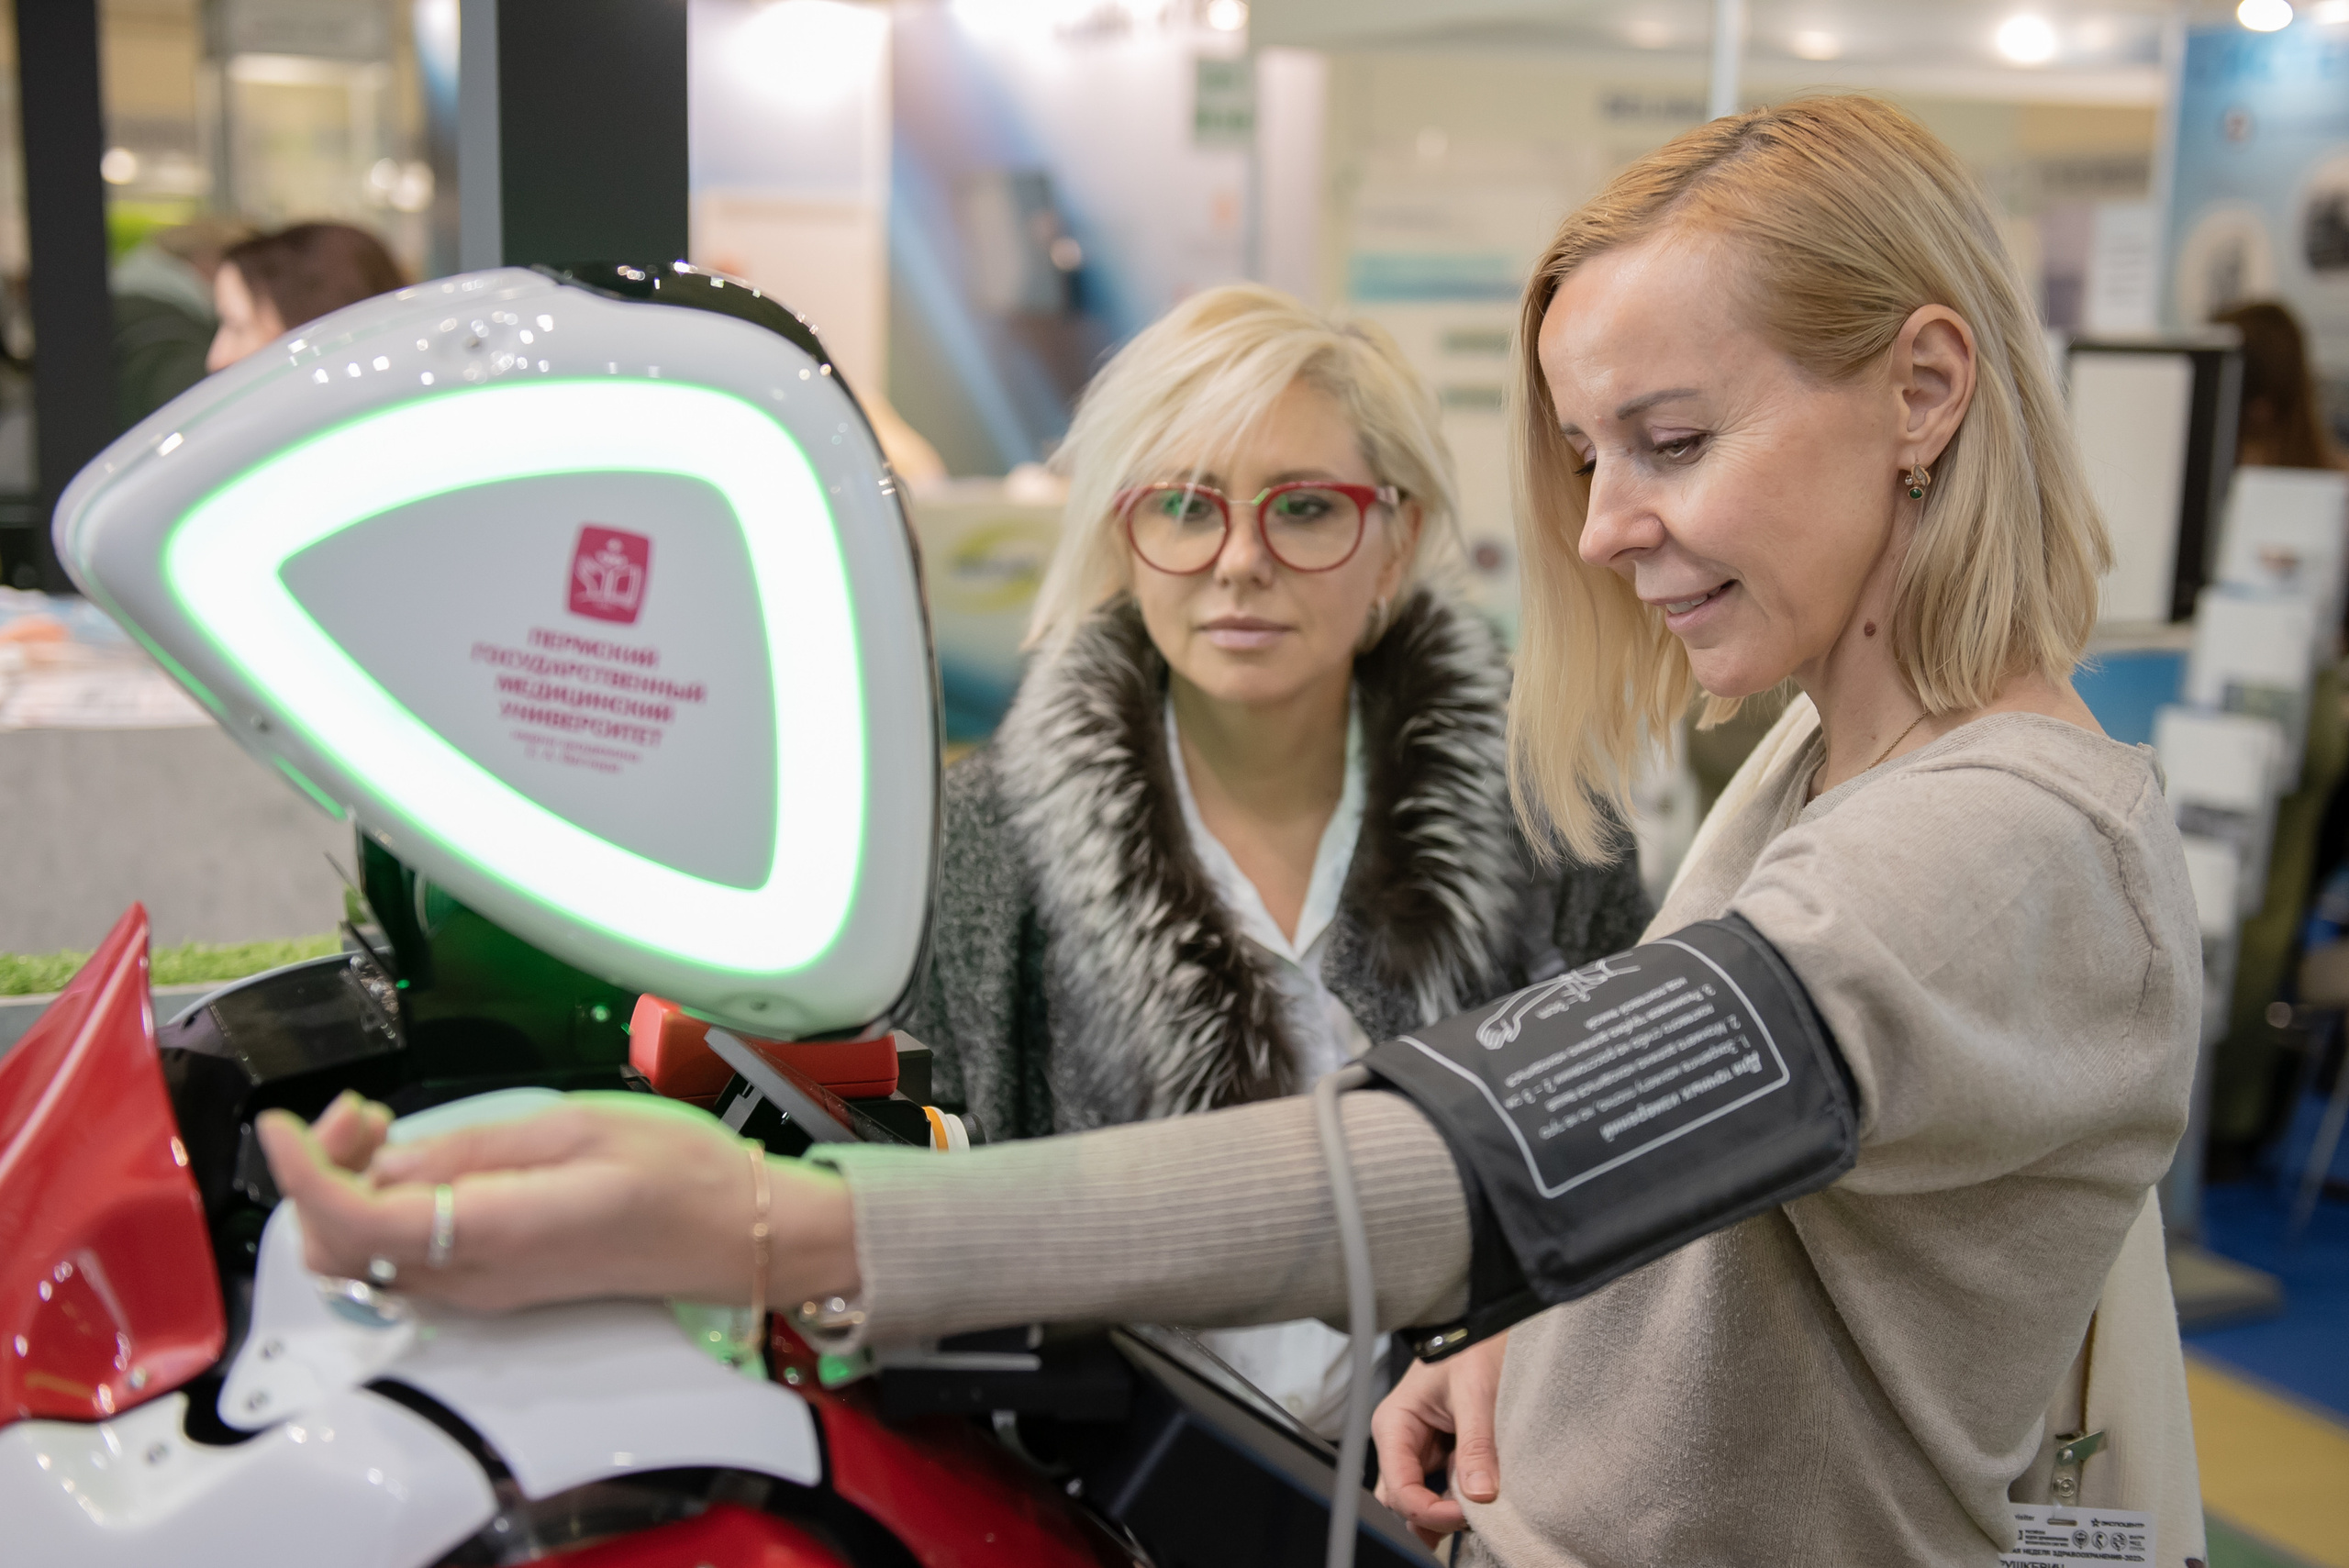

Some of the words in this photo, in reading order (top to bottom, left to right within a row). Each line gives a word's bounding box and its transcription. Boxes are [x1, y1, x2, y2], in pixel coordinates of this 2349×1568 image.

[528, 628, 661, 669] ПЕРМСКИЙ
[470, 641, 707, 704] ГОСУДАРСТВЕННЫЙ
[495, 673, 676, 723] МЕДИЦИНСКИЙ
[498, 700, 663, 747] УНИВЕРСИТЕТ
[1731, 1050, 1762, 1076] Для
[1520, 1088, 1536, 1104] 3
[1542, 1077, 1556, 1093] 2
[1678, 1068, 1733, 1101] точных
[1598, 1091, 1680, 1142] измерений
